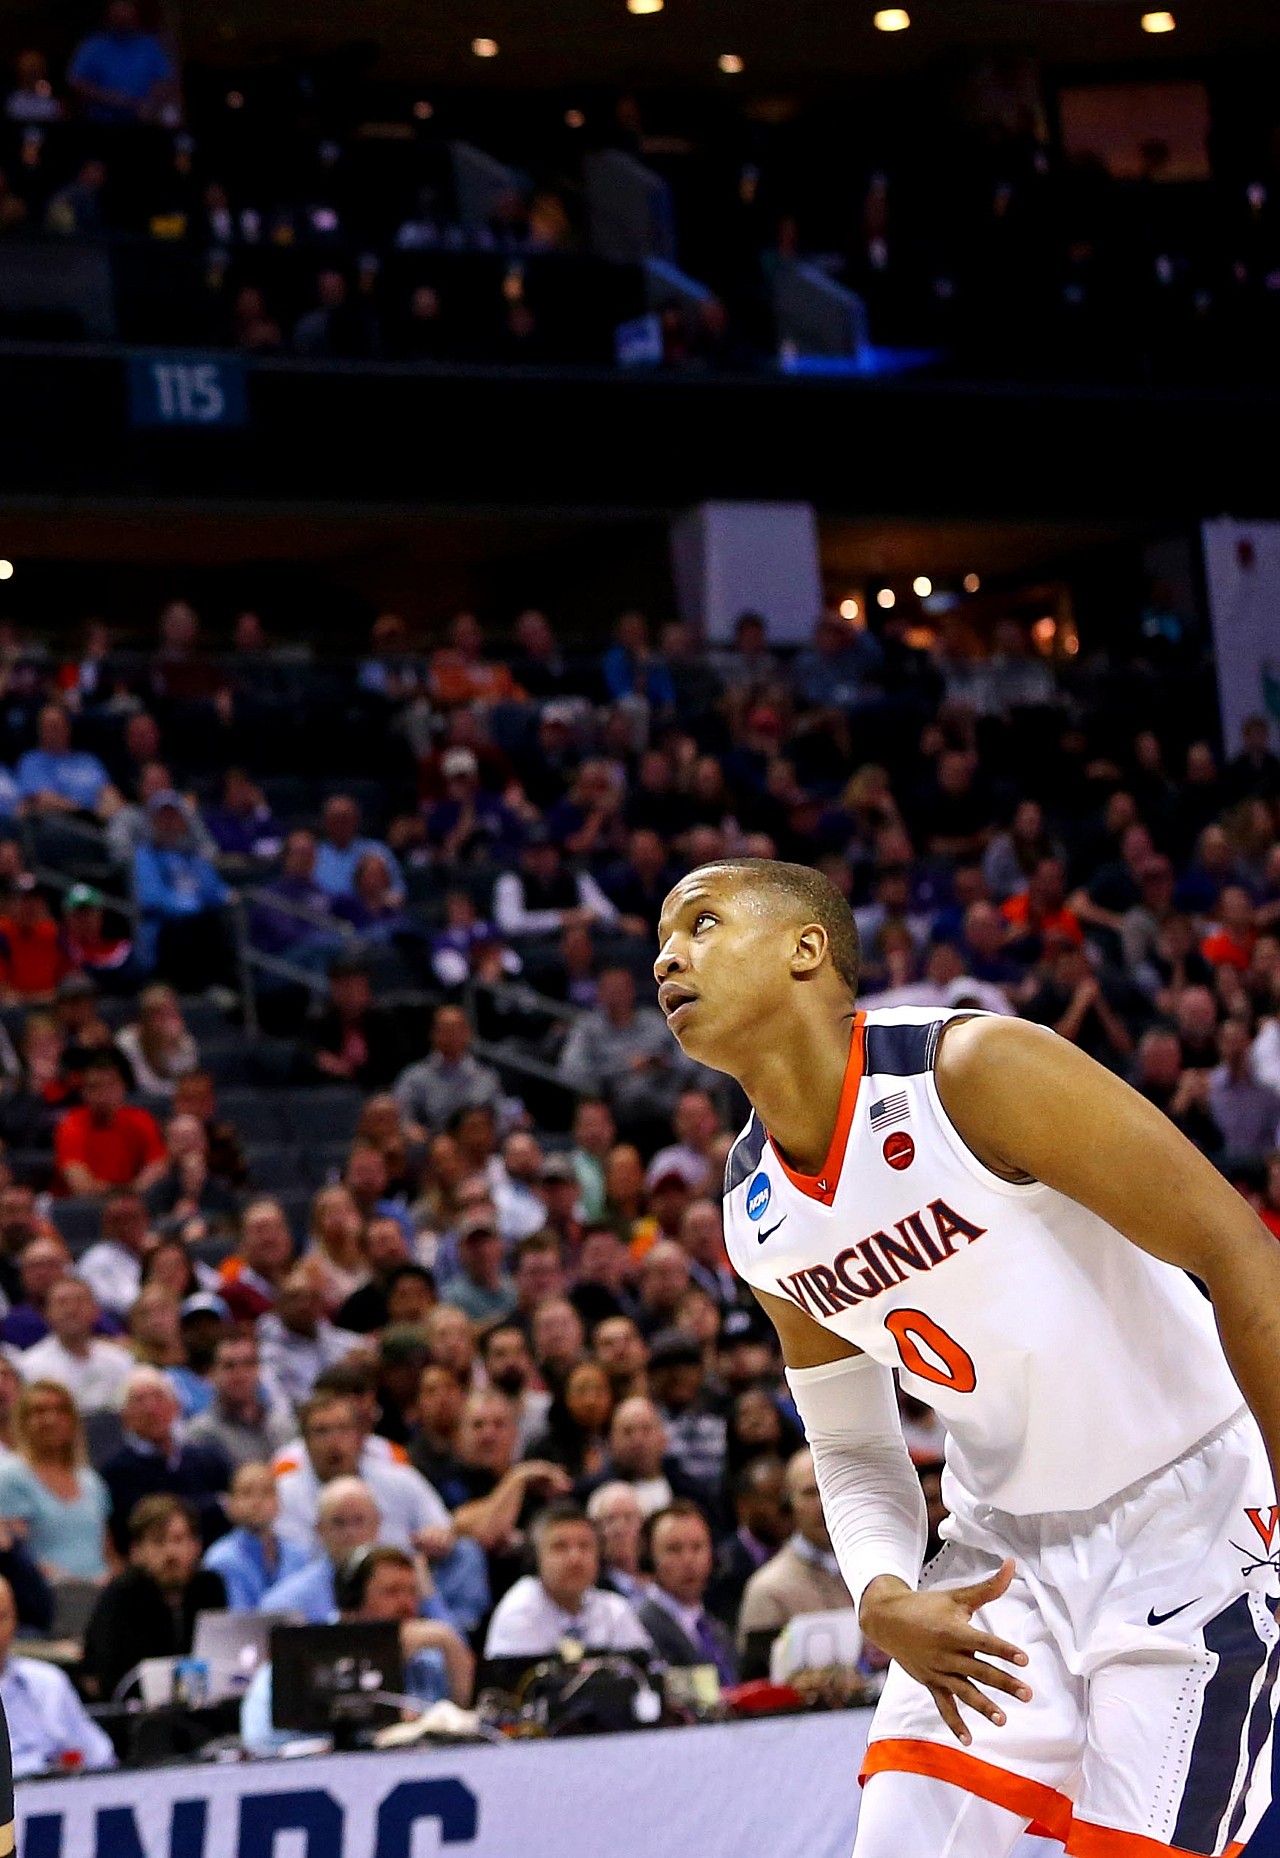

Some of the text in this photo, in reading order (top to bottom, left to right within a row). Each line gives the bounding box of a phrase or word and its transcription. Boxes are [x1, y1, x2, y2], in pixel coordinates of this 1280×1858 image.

[155, 363, 224, 419] 115
[775, 1197, 989, 1319] VIRGINIA
[883, 1307, 978, 1394] 0
